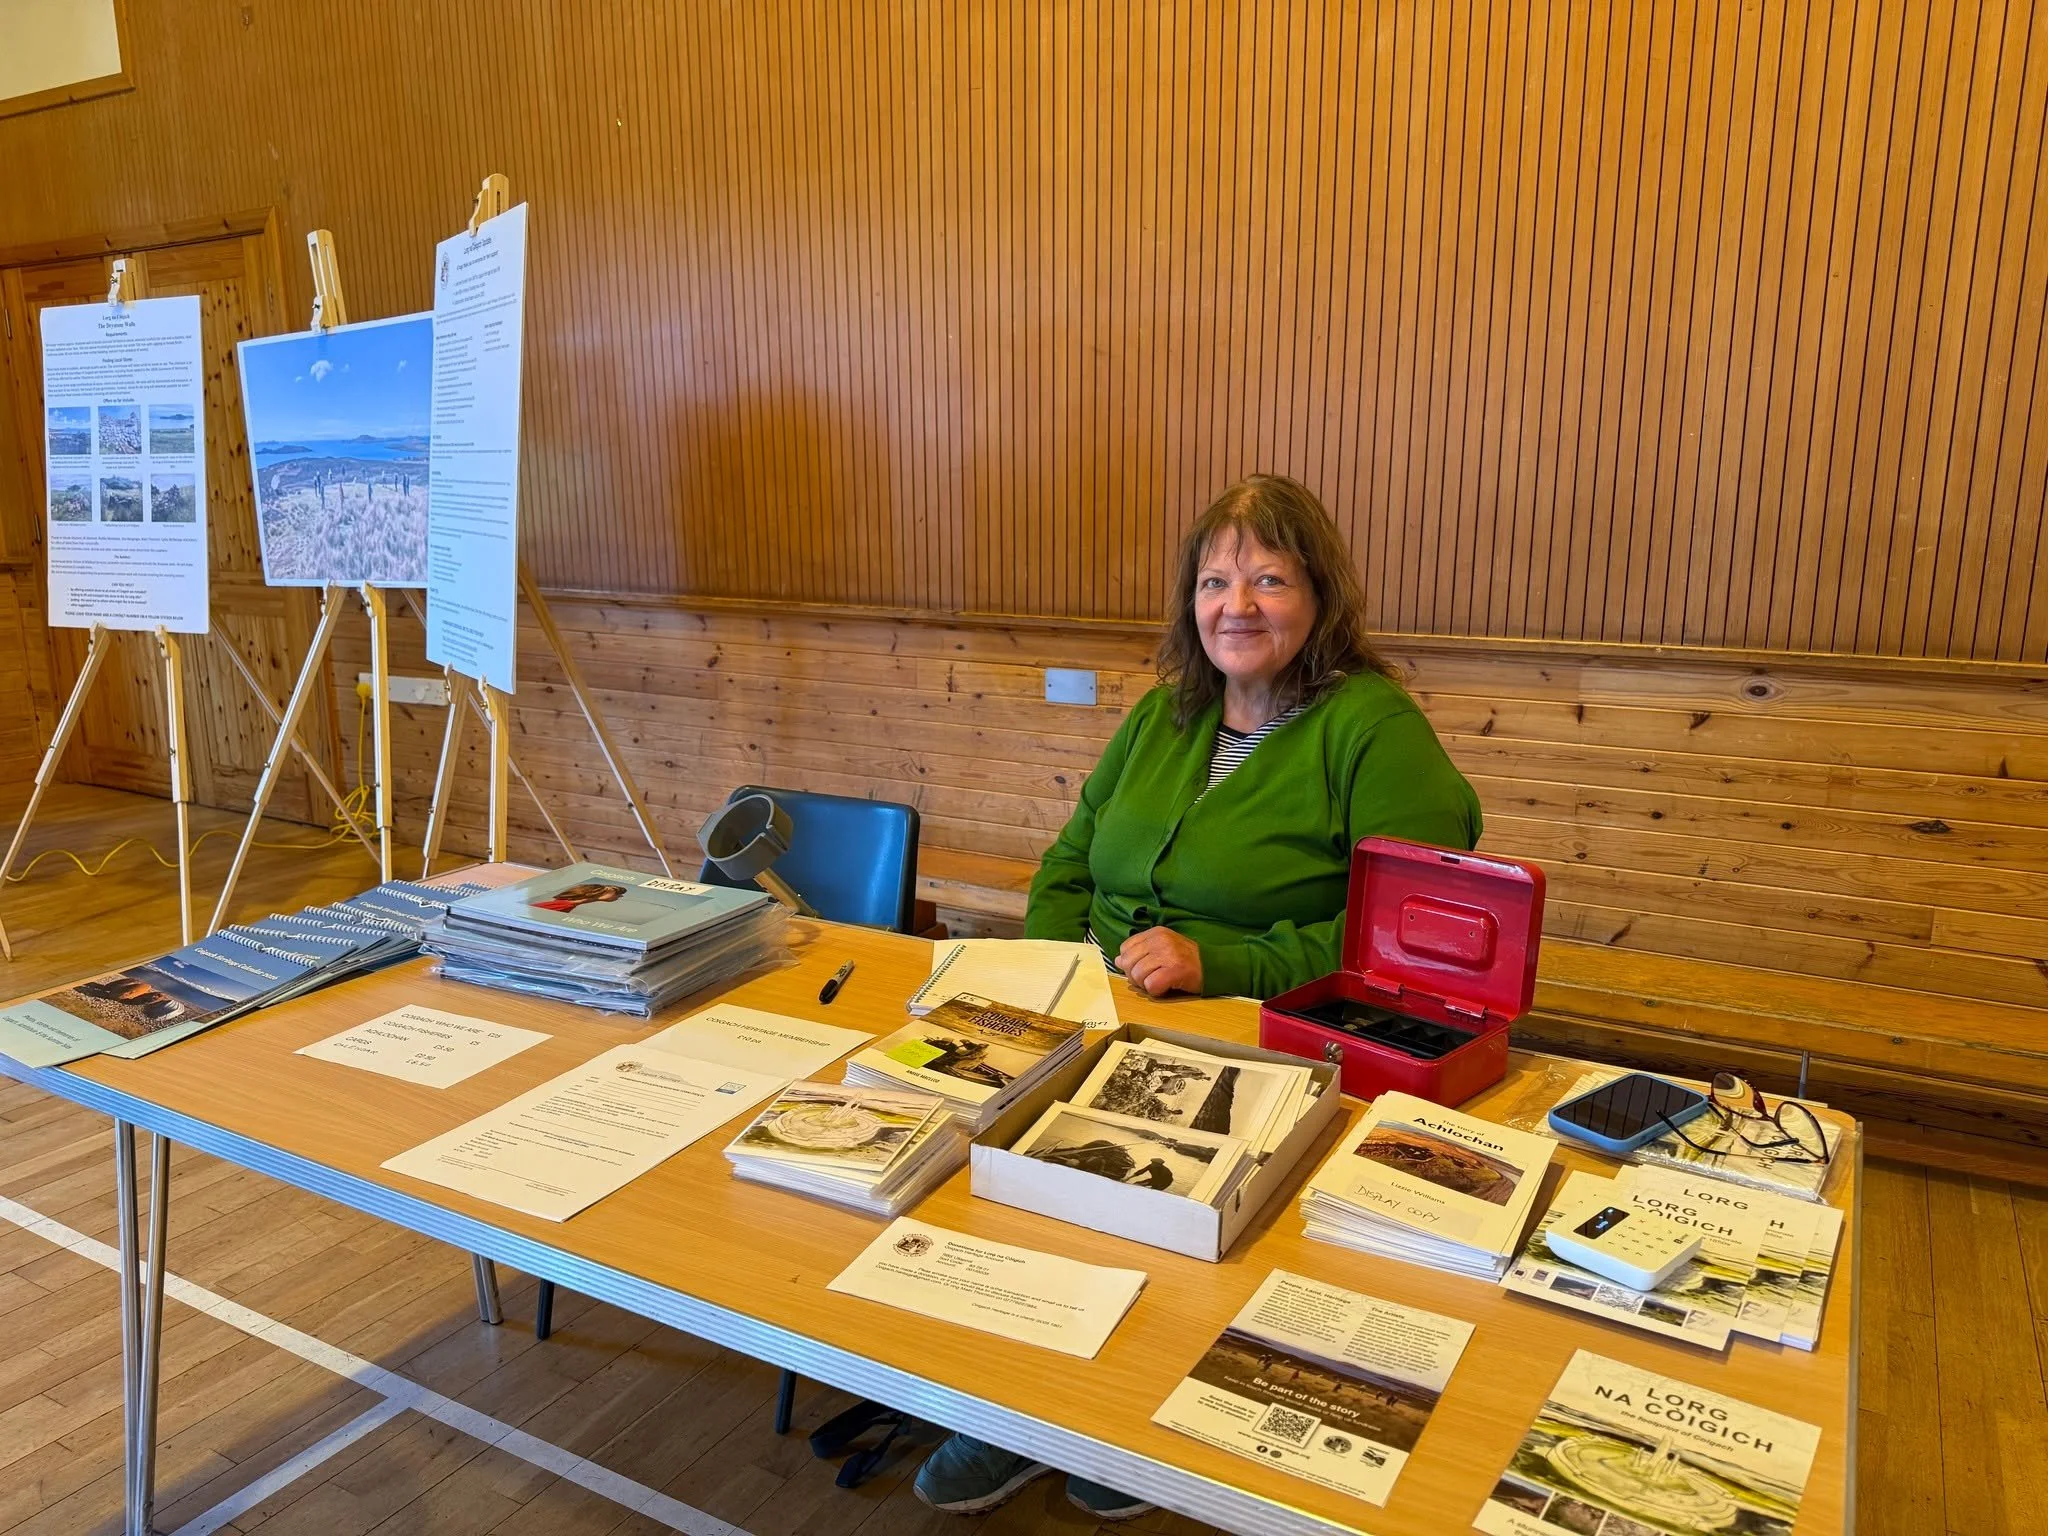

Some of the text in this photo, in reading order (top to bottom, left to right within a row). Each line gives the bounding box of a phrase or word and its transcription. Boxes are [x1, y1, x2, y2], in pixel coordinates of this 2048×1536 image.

[563, 916, 638, 934] Who We Are
[968, 1016, 1028, 1038] FISHERIES
[980, 1010, 1034, 1029] COIGACH
[704, 1017, 831, 1047] COIGACH HERITAGE MEMBERSHIP
[1413, 1118, 1504, 1151] Achlochan
[1354, 1185, 1401, 1209] DISPLAY
[1391, 1182, 1446, 1204] Lizzie Williams
[1683, 1189, 1748, 1210] LORG
[1632, 1195, 1698, 1217] LORG
[947, 1242, 976, 1251] Donations
[1280, 1280, 1352, 1305] People, Land, Heritage
[1215, 1402, 1248, 1416] information
[1253, 1377, 1361, 1419] Be part of the story
[1647, 1387, 1729, 1421] LORG
[1594, 1385, 1773, 1453] NA CÒIGICH
[1620, 1410, 1636, 1418] the
[1638, 1416, 1680, 1433] footprint
